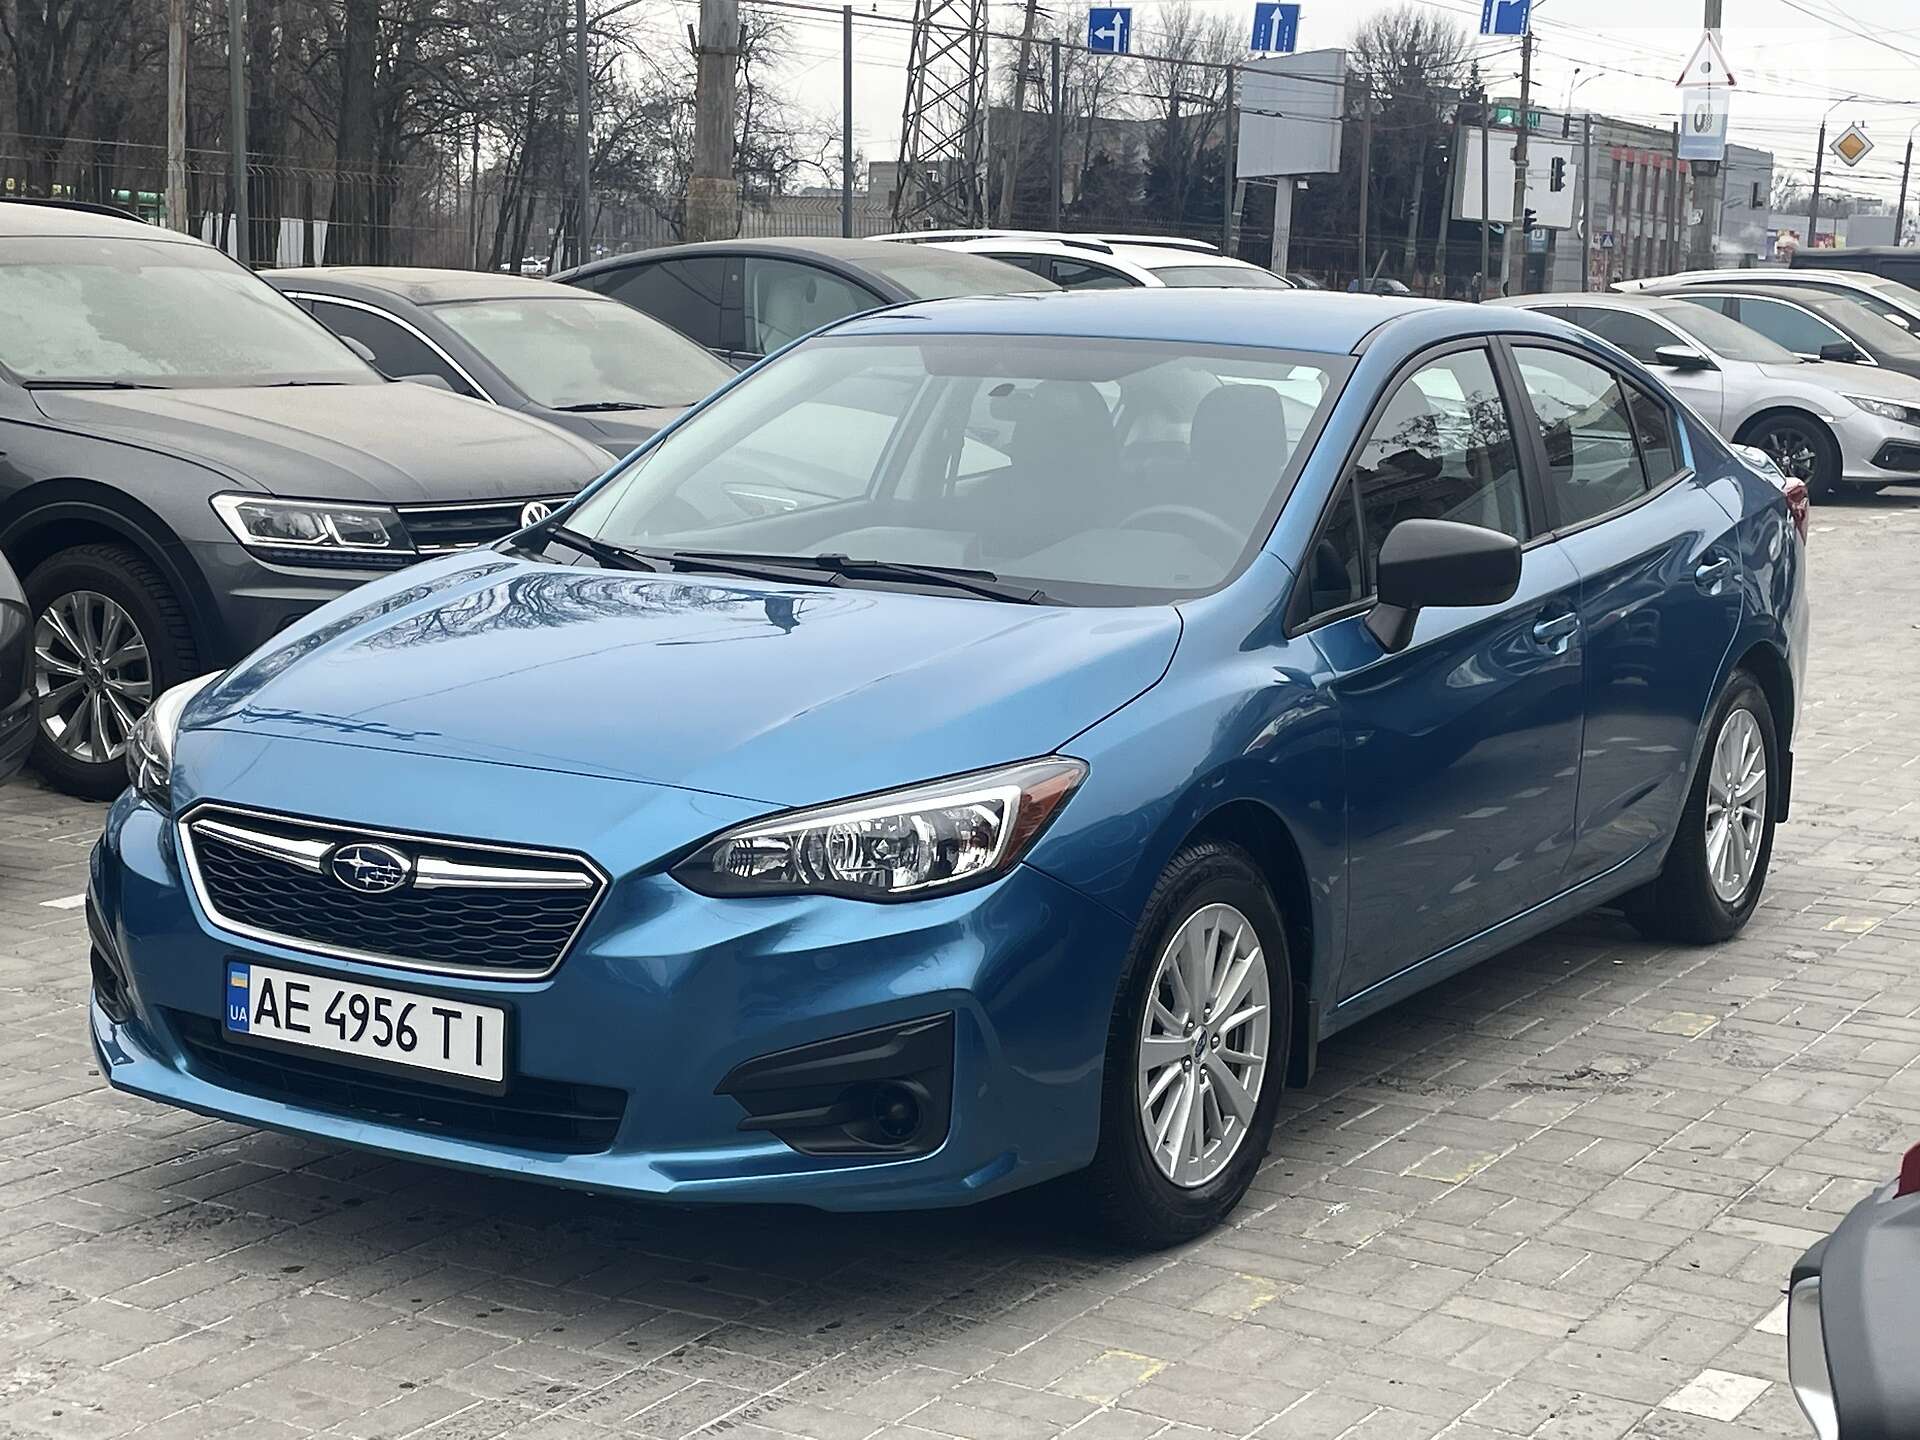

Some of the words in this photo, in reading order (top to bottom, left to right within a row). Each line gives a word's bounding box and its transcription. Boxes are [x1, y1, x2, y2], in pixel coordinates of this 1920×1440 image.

[230, 1004, 248, 1022] UA
[254, 978, 311, 1034] AE
[325, 990, 418, 1051] 4956
